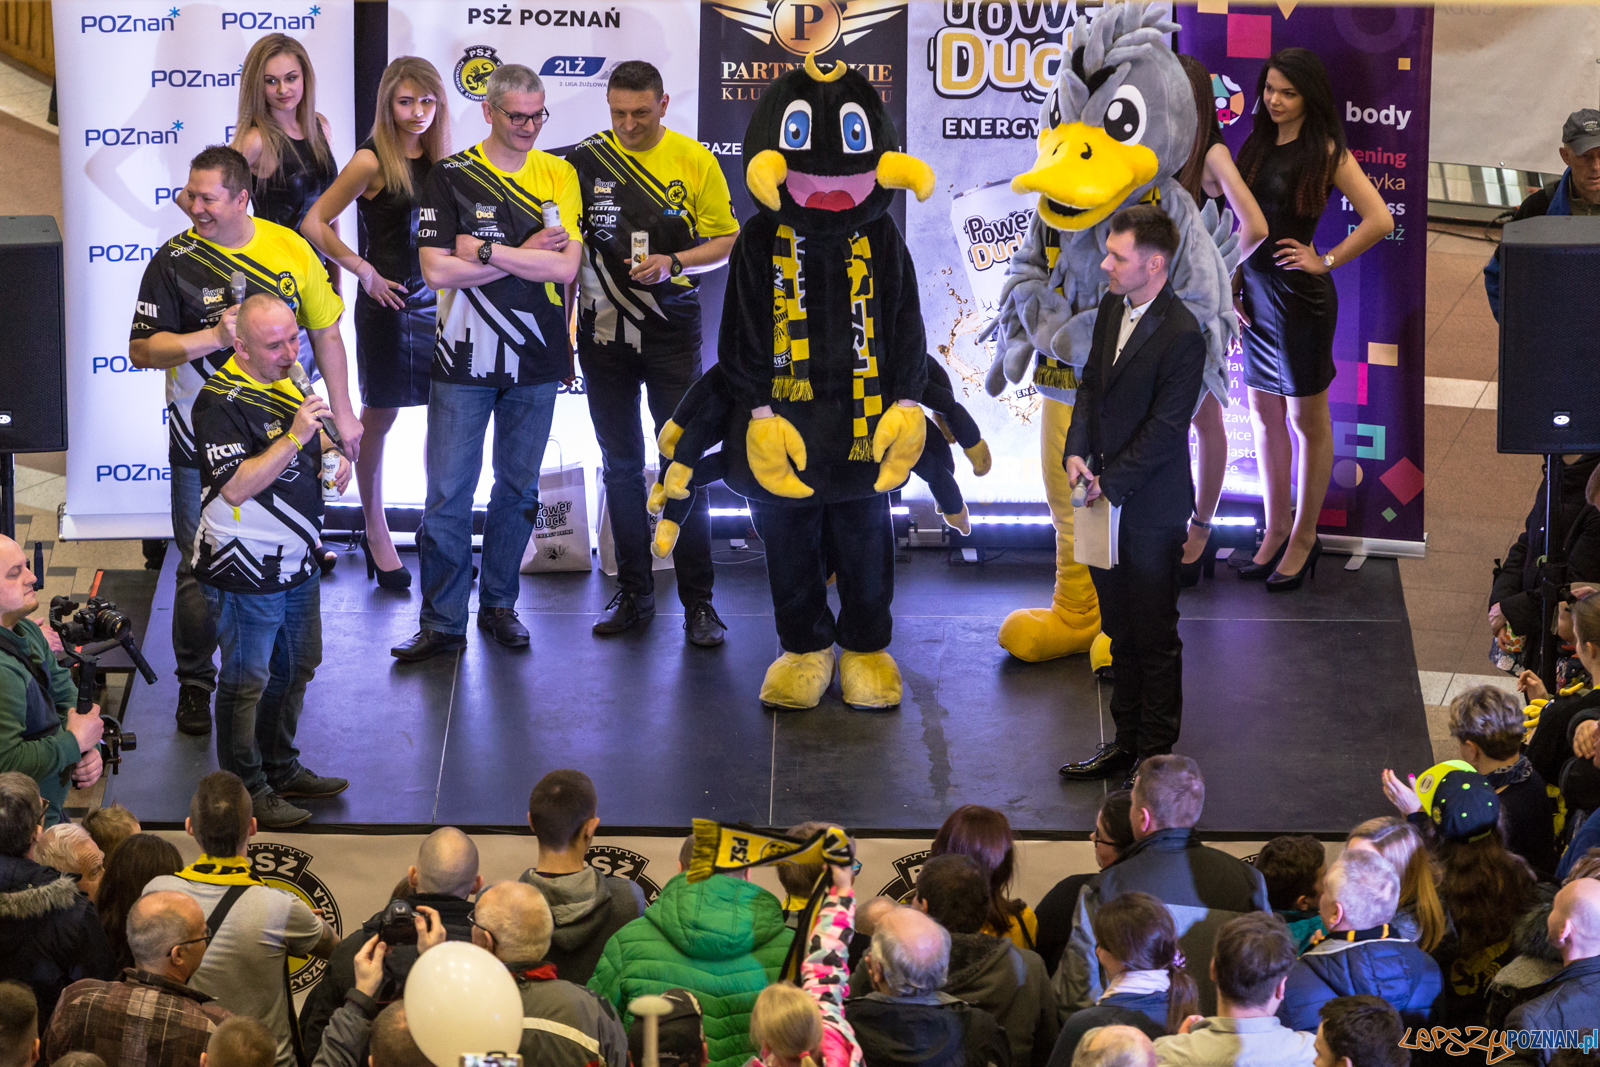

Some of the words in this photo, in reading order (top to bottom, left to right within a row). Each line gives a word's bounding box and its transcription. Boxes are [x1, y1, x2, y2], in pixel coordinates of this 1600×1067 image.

[467, 4, 512, 25] PSŻ
[519, 7, 621, 28] POZNAŃ
[554, 57, 586, 75] 2LŻ
[936, 27, 1073, 95] Duc
[1346, 101, 1412, 130] body
[535, 514, 566, 529] Duck
[250, 853, 298, 877] SŻ
[583, 856, 634, 879] SŻ
